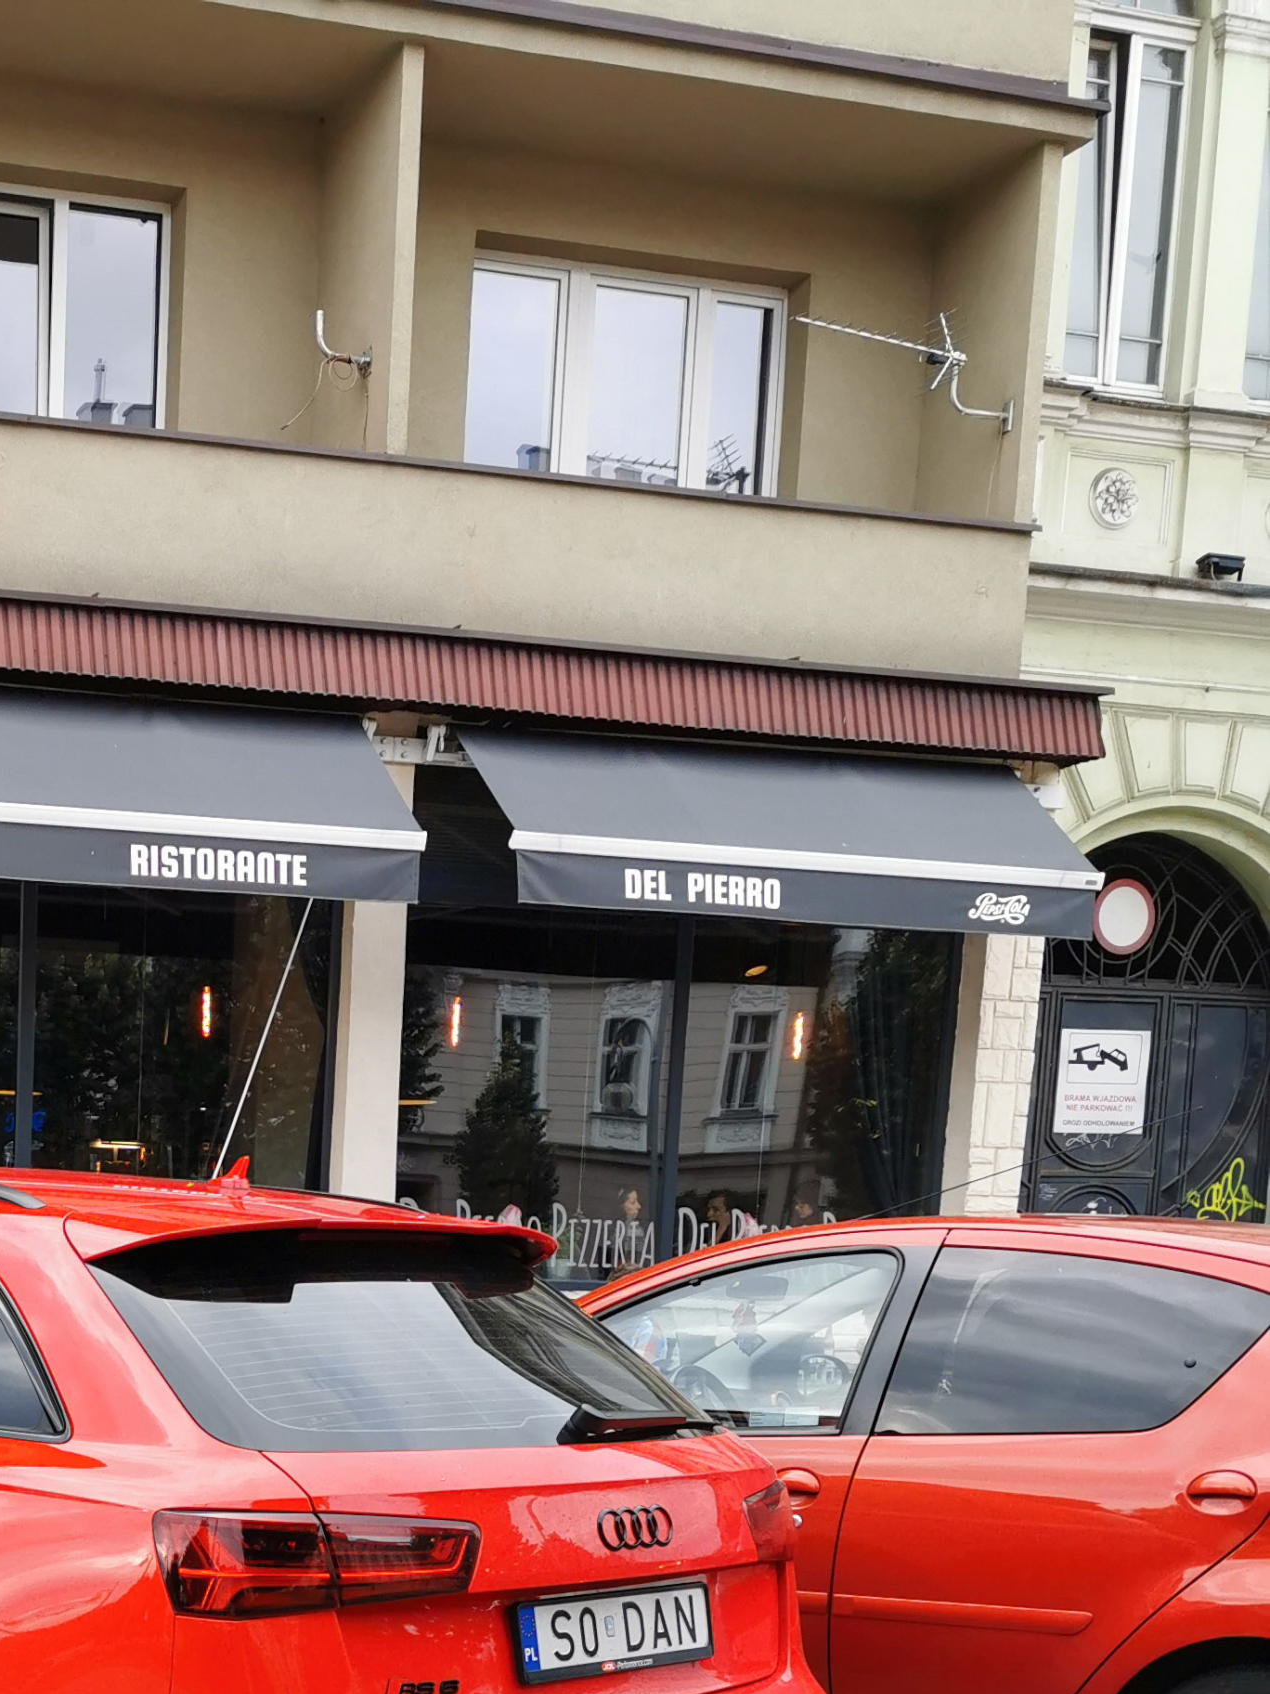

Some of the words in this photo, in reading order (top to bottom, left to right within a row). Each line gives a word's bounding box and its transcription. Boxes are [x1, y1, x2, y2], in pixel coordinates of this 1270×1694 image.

[130, 844, 307, 887] RISTORANTE
[625, 868, 672, 901] DEL
[687, 872, 781, 910] PIERRO
[1064, 1094, 1091, 1102] BRAMA
[1092, 1095, 1137, 1103] WJAZDOWA
[1066, 1103, 1079, 1112] NIE
[1080, 1103, 1123, 1112] PARKOWAĆ
[622, 1594, 697, 1653] DAN
[524, 1647, 539, 1663] PL
